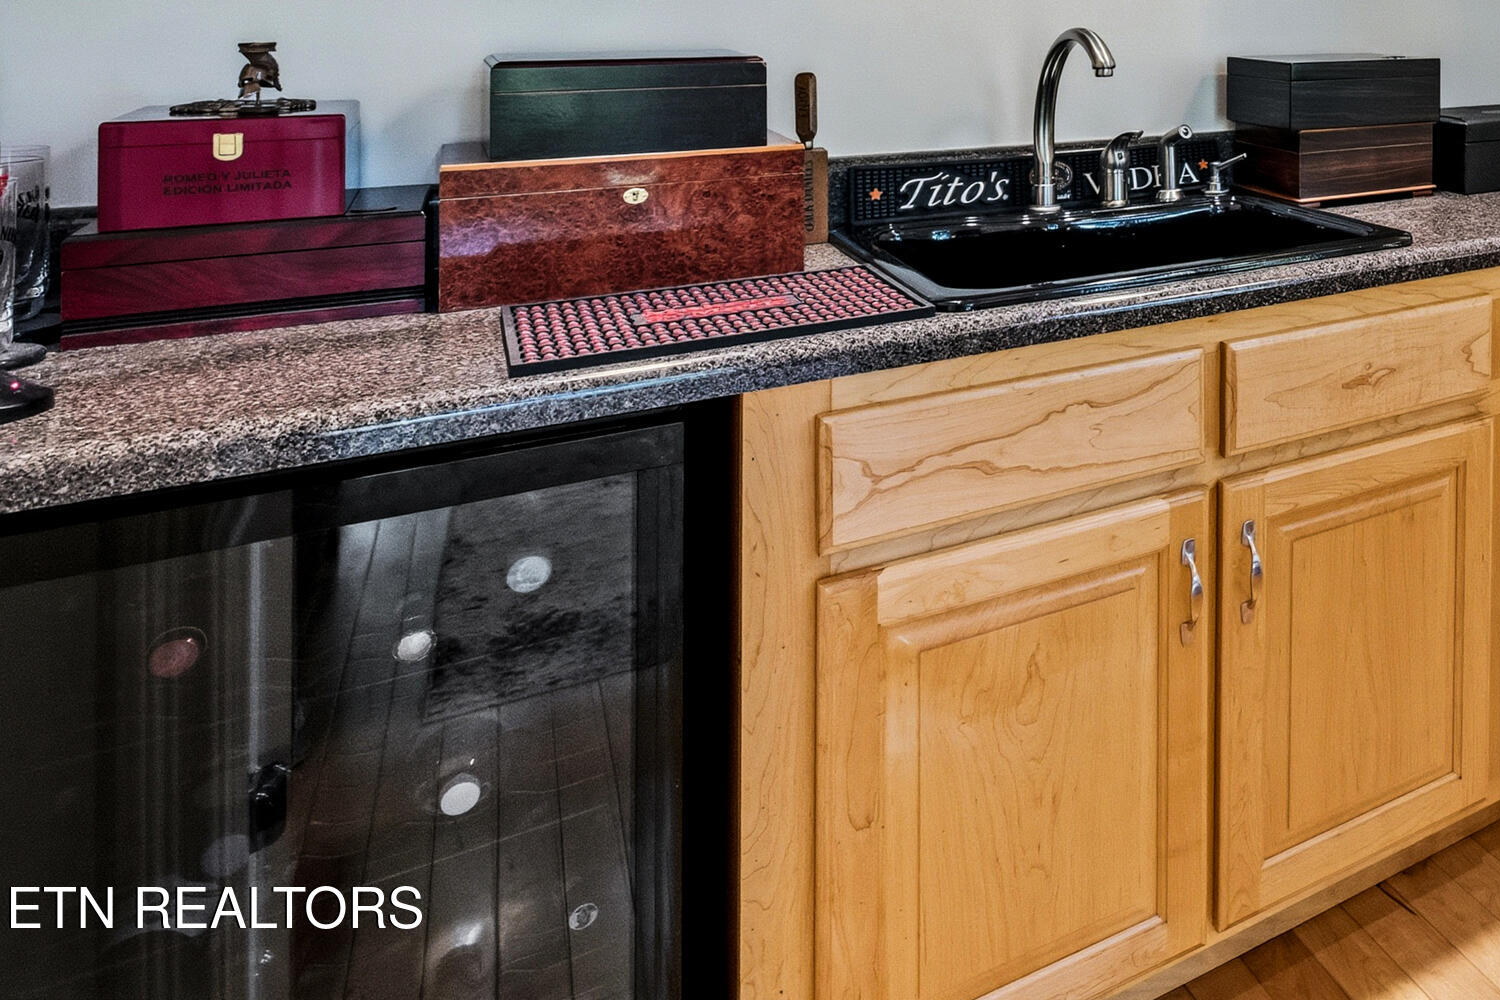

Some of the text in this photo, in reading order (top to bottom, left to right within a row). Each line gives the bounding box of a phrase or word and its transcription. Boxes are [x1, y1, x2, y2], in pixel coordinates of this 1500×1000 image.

[163, 168, 292, 184] ROMEO Y JULIETA
[227, 180, 292, 193] LIMITADA
